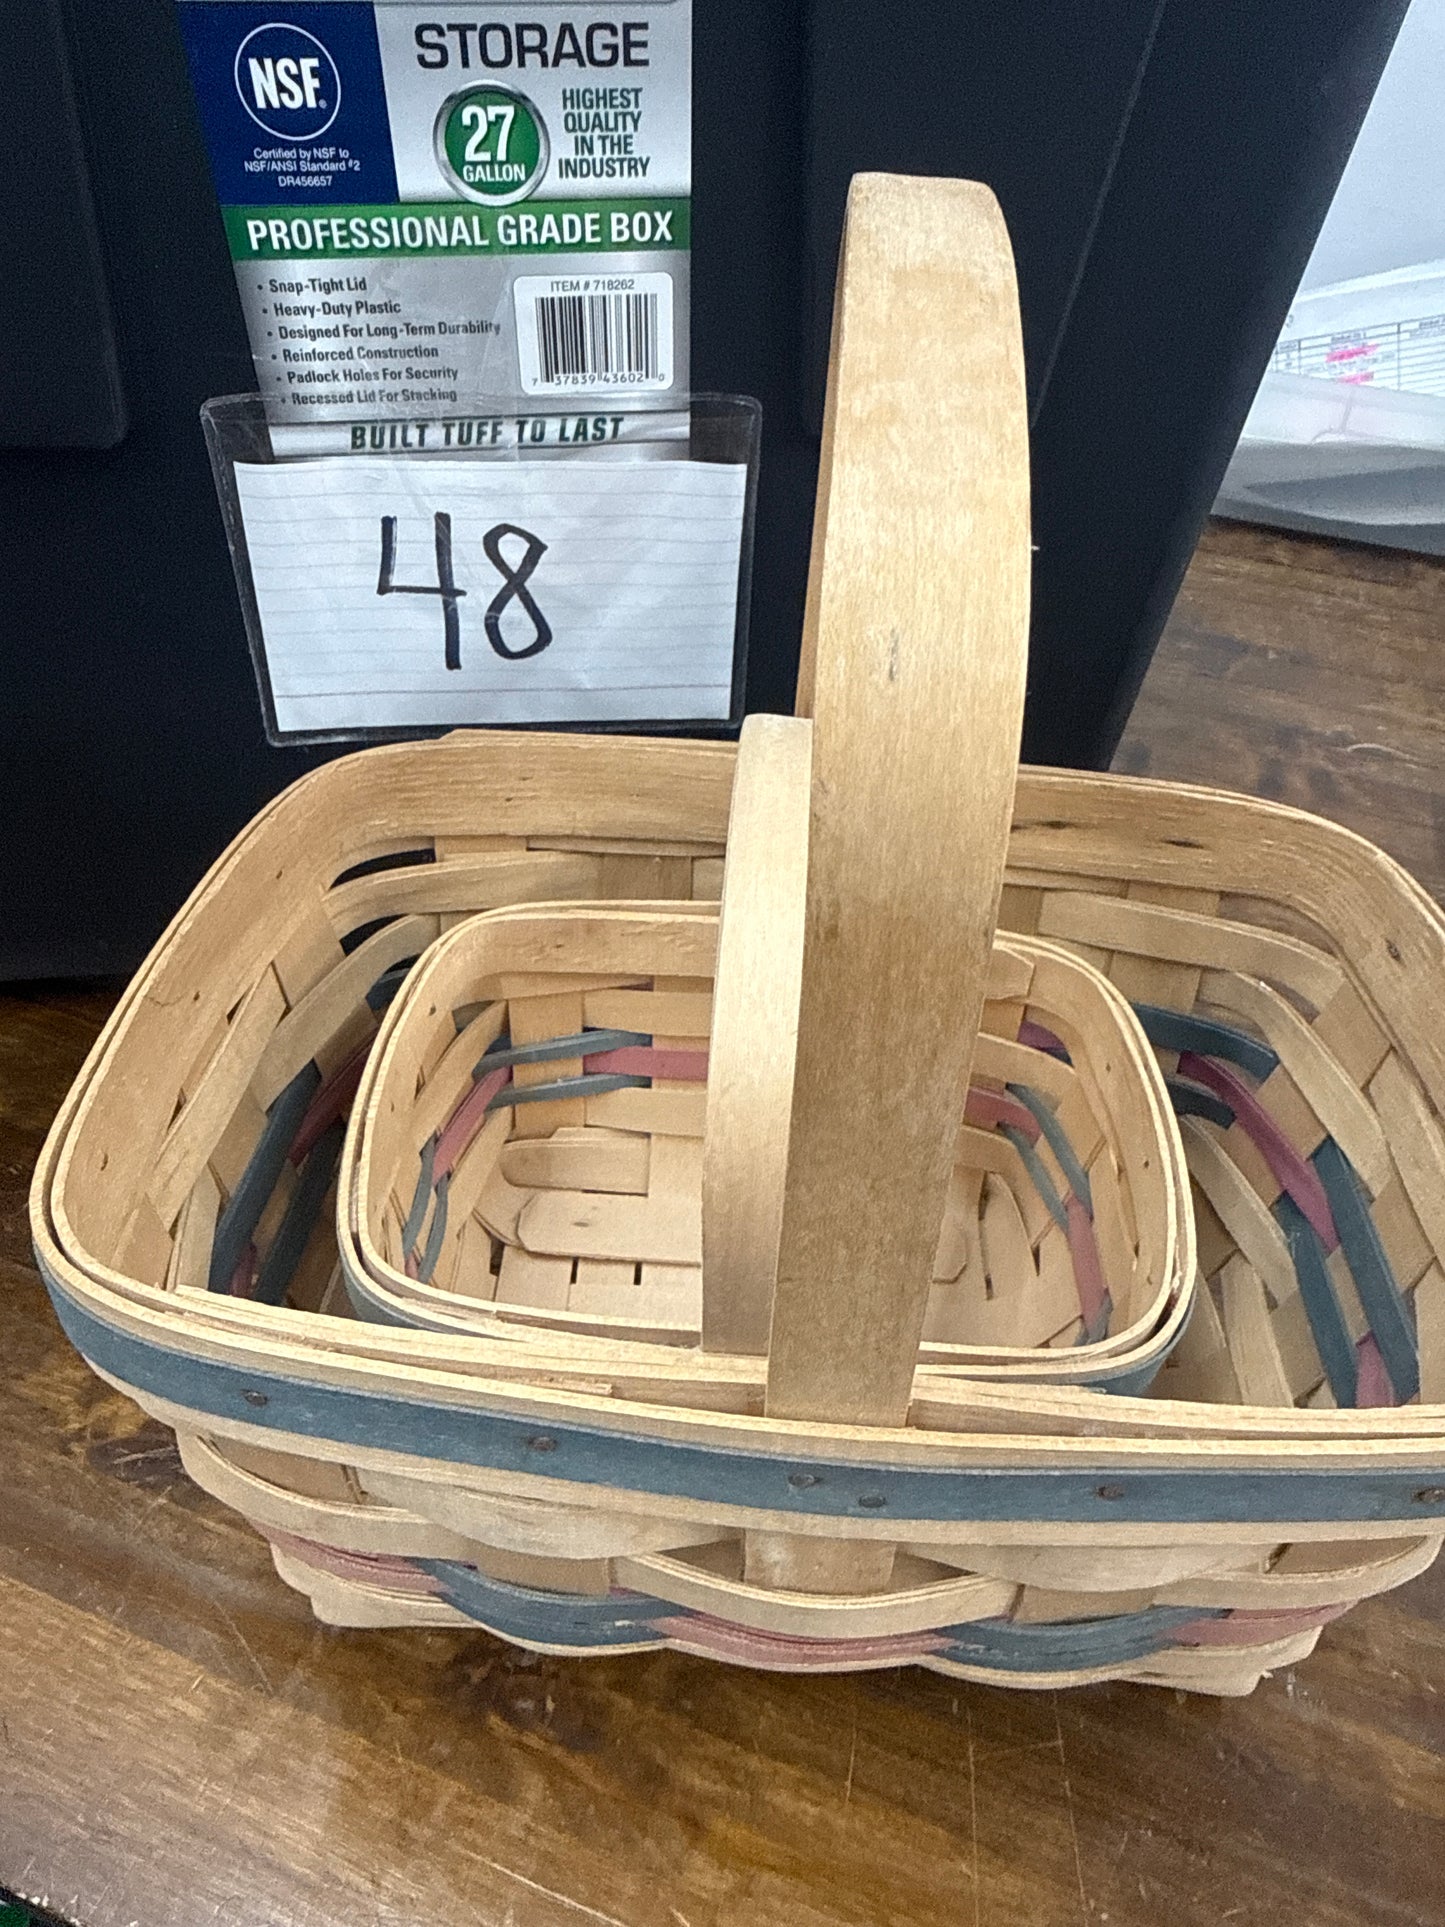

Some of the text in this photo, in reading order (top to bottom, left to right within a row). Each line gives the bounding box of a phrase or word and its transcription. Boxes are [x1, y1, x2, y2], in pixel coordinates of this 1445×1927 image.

[414, 22, 650, 70] STORAGE
[248, 57, 320, 109] NSF
[562, 87, 643, 110] HIGHEST
[564, 111, 642, 133] QUALITY
[461, 104, 515, 163] 27
[253, 147, 350, 160] Certified by NSF to
[574, 134, 633, 156] IN THE
[244, 161, 297, 172] NSF/ANSI
[299, 160, 346, 171] Standard
[463, 163, 526, 182] GALLON
[558, 156, 651, 179] INDUSTRY
[246, 210, 673, 251] PROFESSIONAL GRADE BOX
[268, 277, 368, 296] Snap-Tight Lid
[550, 280, 581, 292] ITEM
[273, 300, 402, 319] Heavy-Duty Plastic
[278, 320, 501, 342] Designed For Long-Term Durability
[282, 344, 439, 363] Reinforced Construction
[287, 366, 458, 384] Padlock Holes For Security
[532, 373, 665, 387] 7 37839 43602 0
[292, 387, 458, 405] Recessed Lid For Stacking
[351, 417, 625, 450] BUILT TUFF TO LAST
[376, 511, 553, 671] 48
